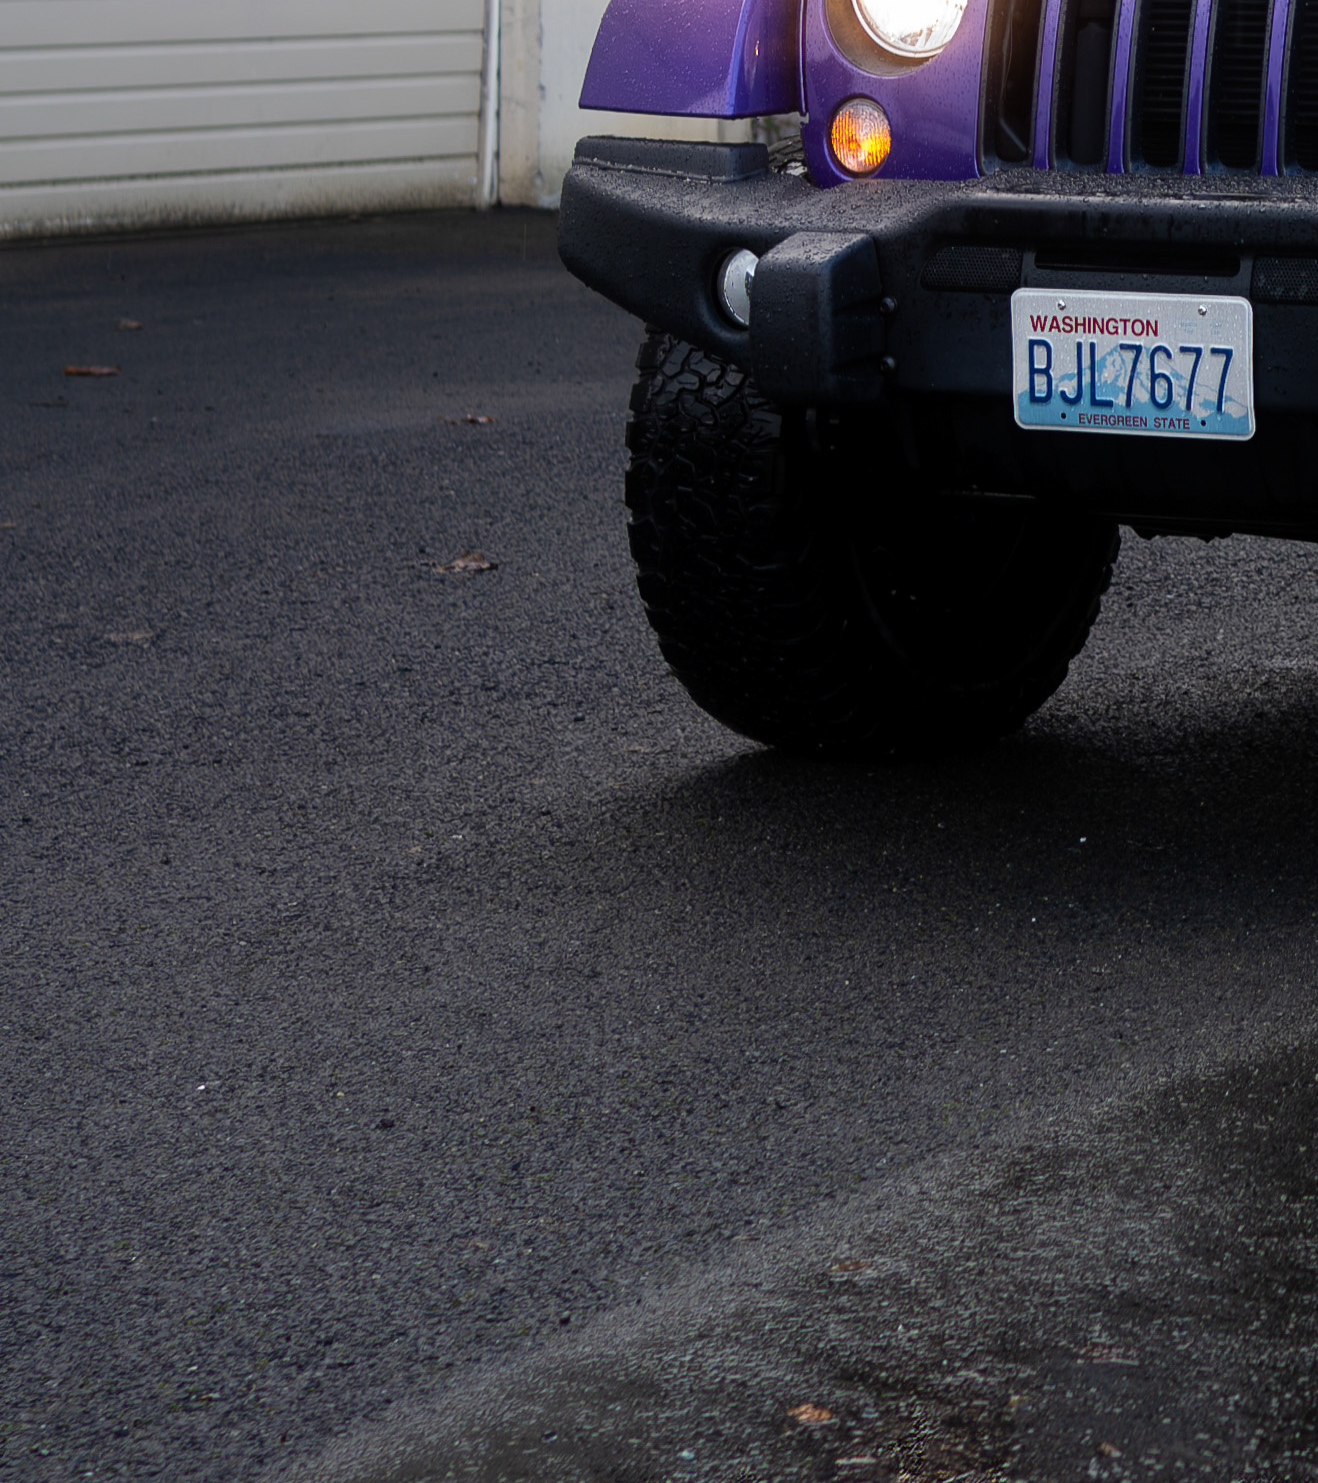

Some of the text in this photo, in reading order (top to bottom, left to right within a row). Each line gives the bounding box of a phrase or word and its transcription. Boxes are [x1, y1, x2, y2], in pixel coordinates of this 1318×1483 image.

[1030, 315, 1159, 337] WASHINGTON
[1028, 338, 1234, 414] BJL7677
[1078, 413, 1190, 430] EVERGREEN STATE
